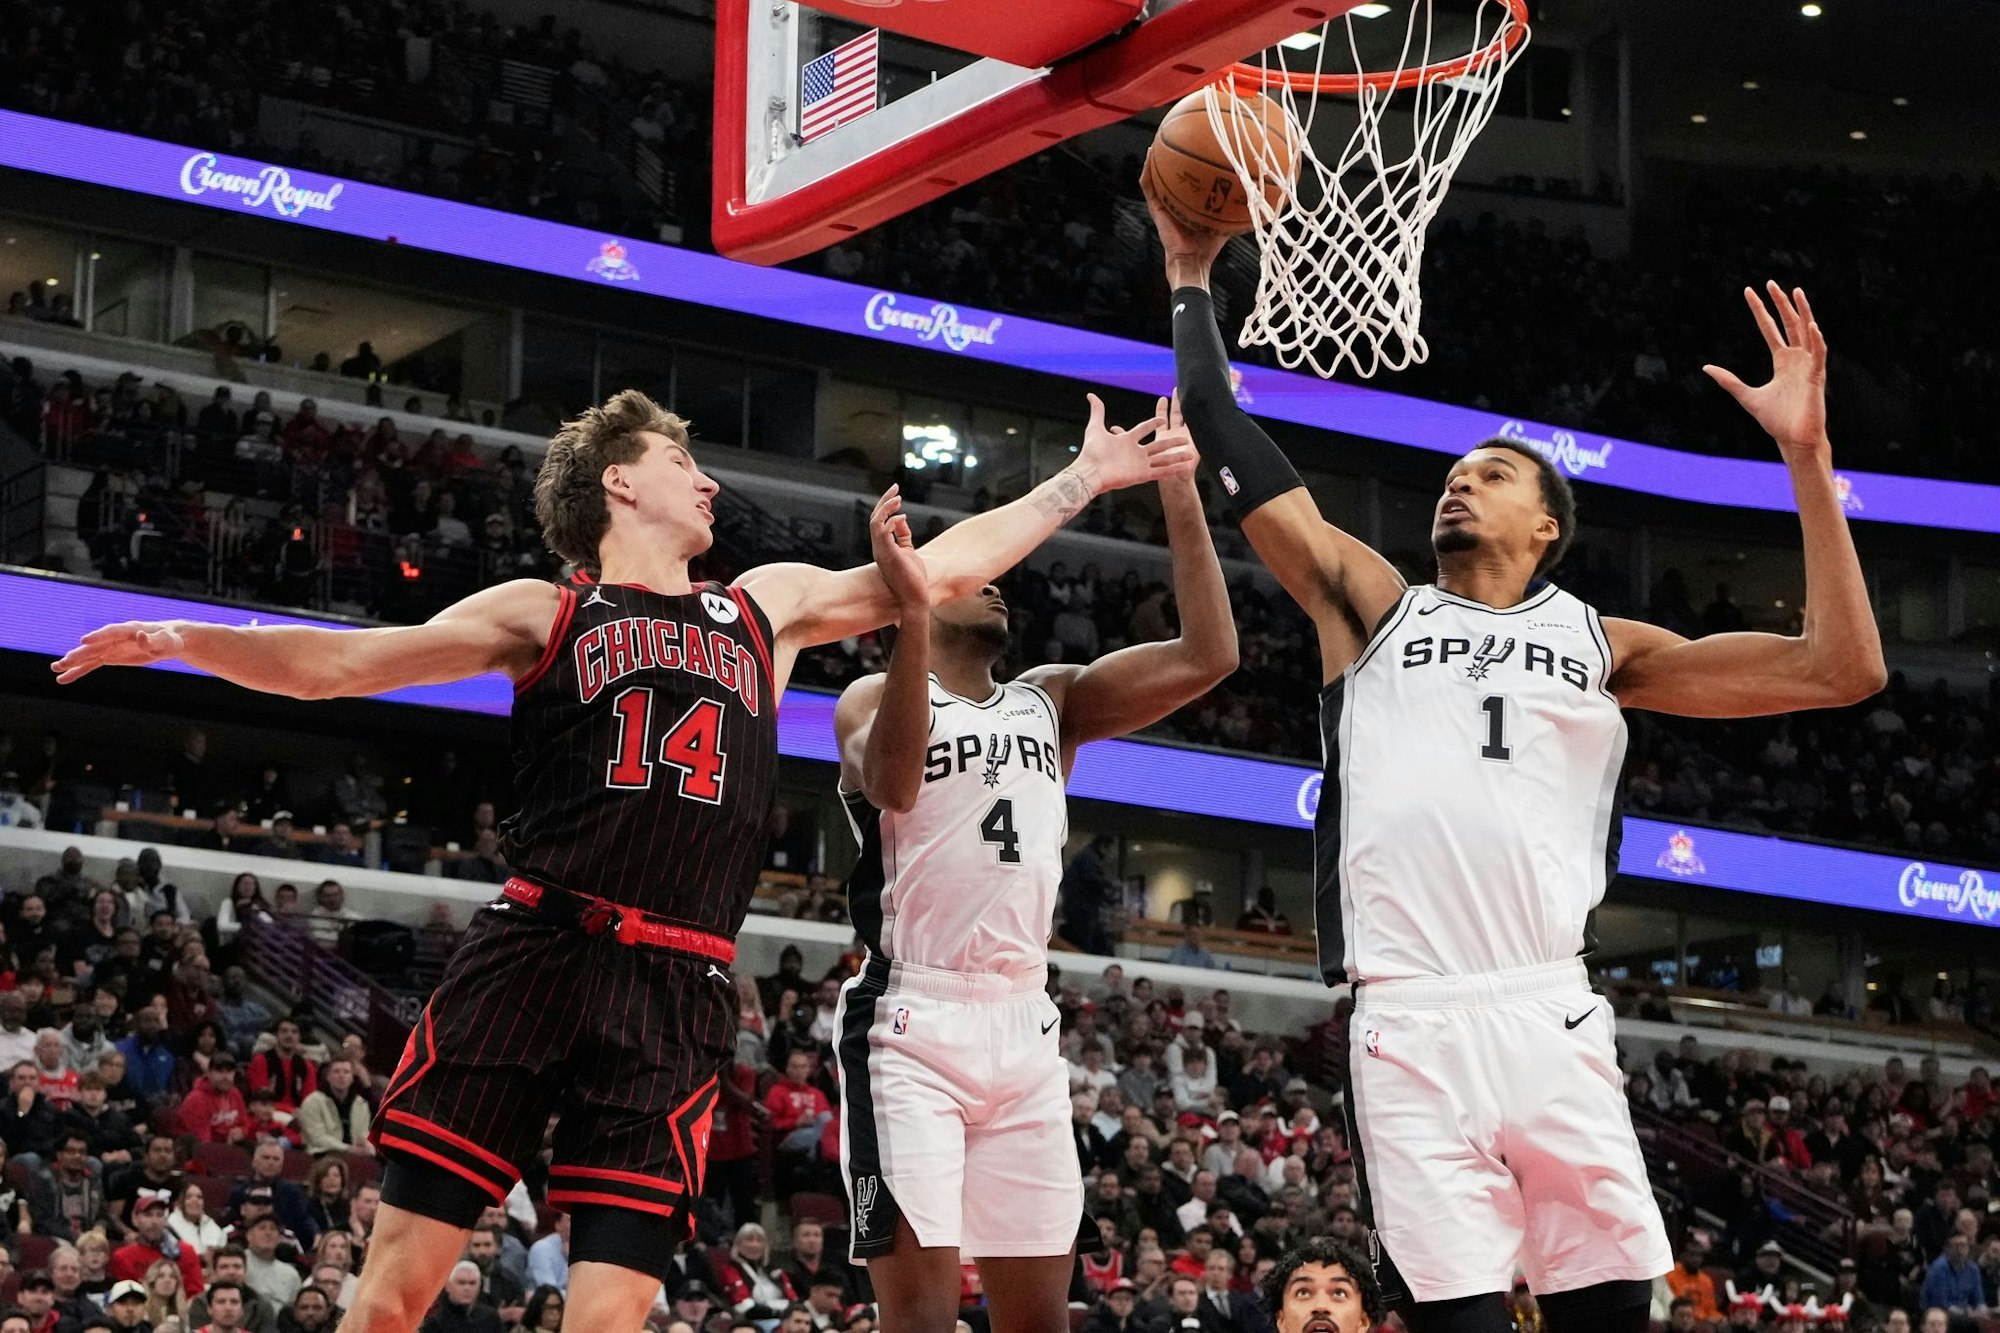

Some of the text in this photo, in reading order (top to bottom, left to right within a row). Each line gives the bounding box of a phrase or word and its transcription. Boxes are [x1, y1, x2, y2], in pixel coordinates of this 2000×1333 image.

[180, 152, 344, 217] Crown Royal
[864, 291, 1003, 351] Crown Royal
[574, 617, 758, 717] CHICAGO
[1403, 635, 1589, 692] SPURS
[1004, 708, 1036, 717] LEDGER
[1478, 693, 1513, 764] 1
[606, 686, 727, 805] 14
[924, 733, 1057, 788] SPURS
[977, 795, 1023, 866] 4
[1898, 862, 1960, 907] Crown
